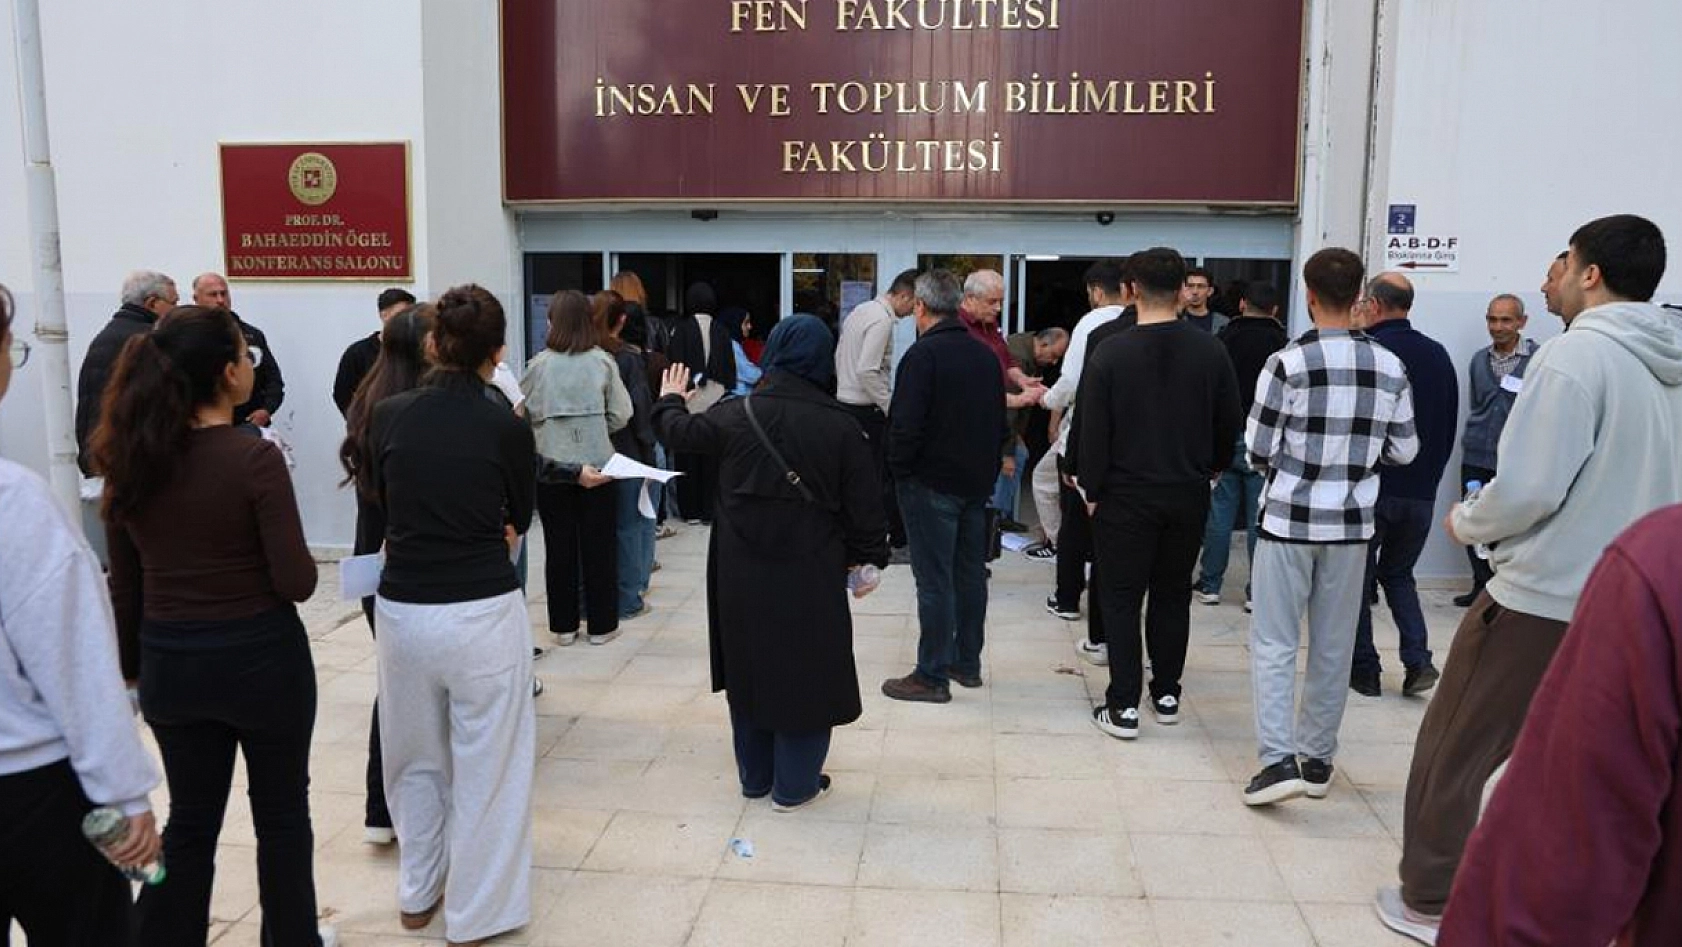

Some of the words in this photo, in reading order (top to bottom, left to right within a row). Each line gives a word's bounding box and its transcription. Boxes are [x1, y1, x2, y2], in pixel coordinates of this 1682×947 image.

[730, 0, 807, 31] FEN
[595, 79, 716, 117] İNSAN
[736, 83, 791, 117] VE
[811, 81, 989, 114] TOPLUM
[1005, 72, 1216, 114] BİLİMLERİ
[782, 132, 1004, 173] FAKÜLTESİ
[1398, 213, 1406, 225] 2
[241, 230, 341, 247] BAHAEDDİN
[346, 230, 391, 247] ÖGEL
[1388, 237, 1457, 249] A-B-D-F
[233, 256, 332, 270] KONFERANS
[335, 256, 402, 270] SALONU
